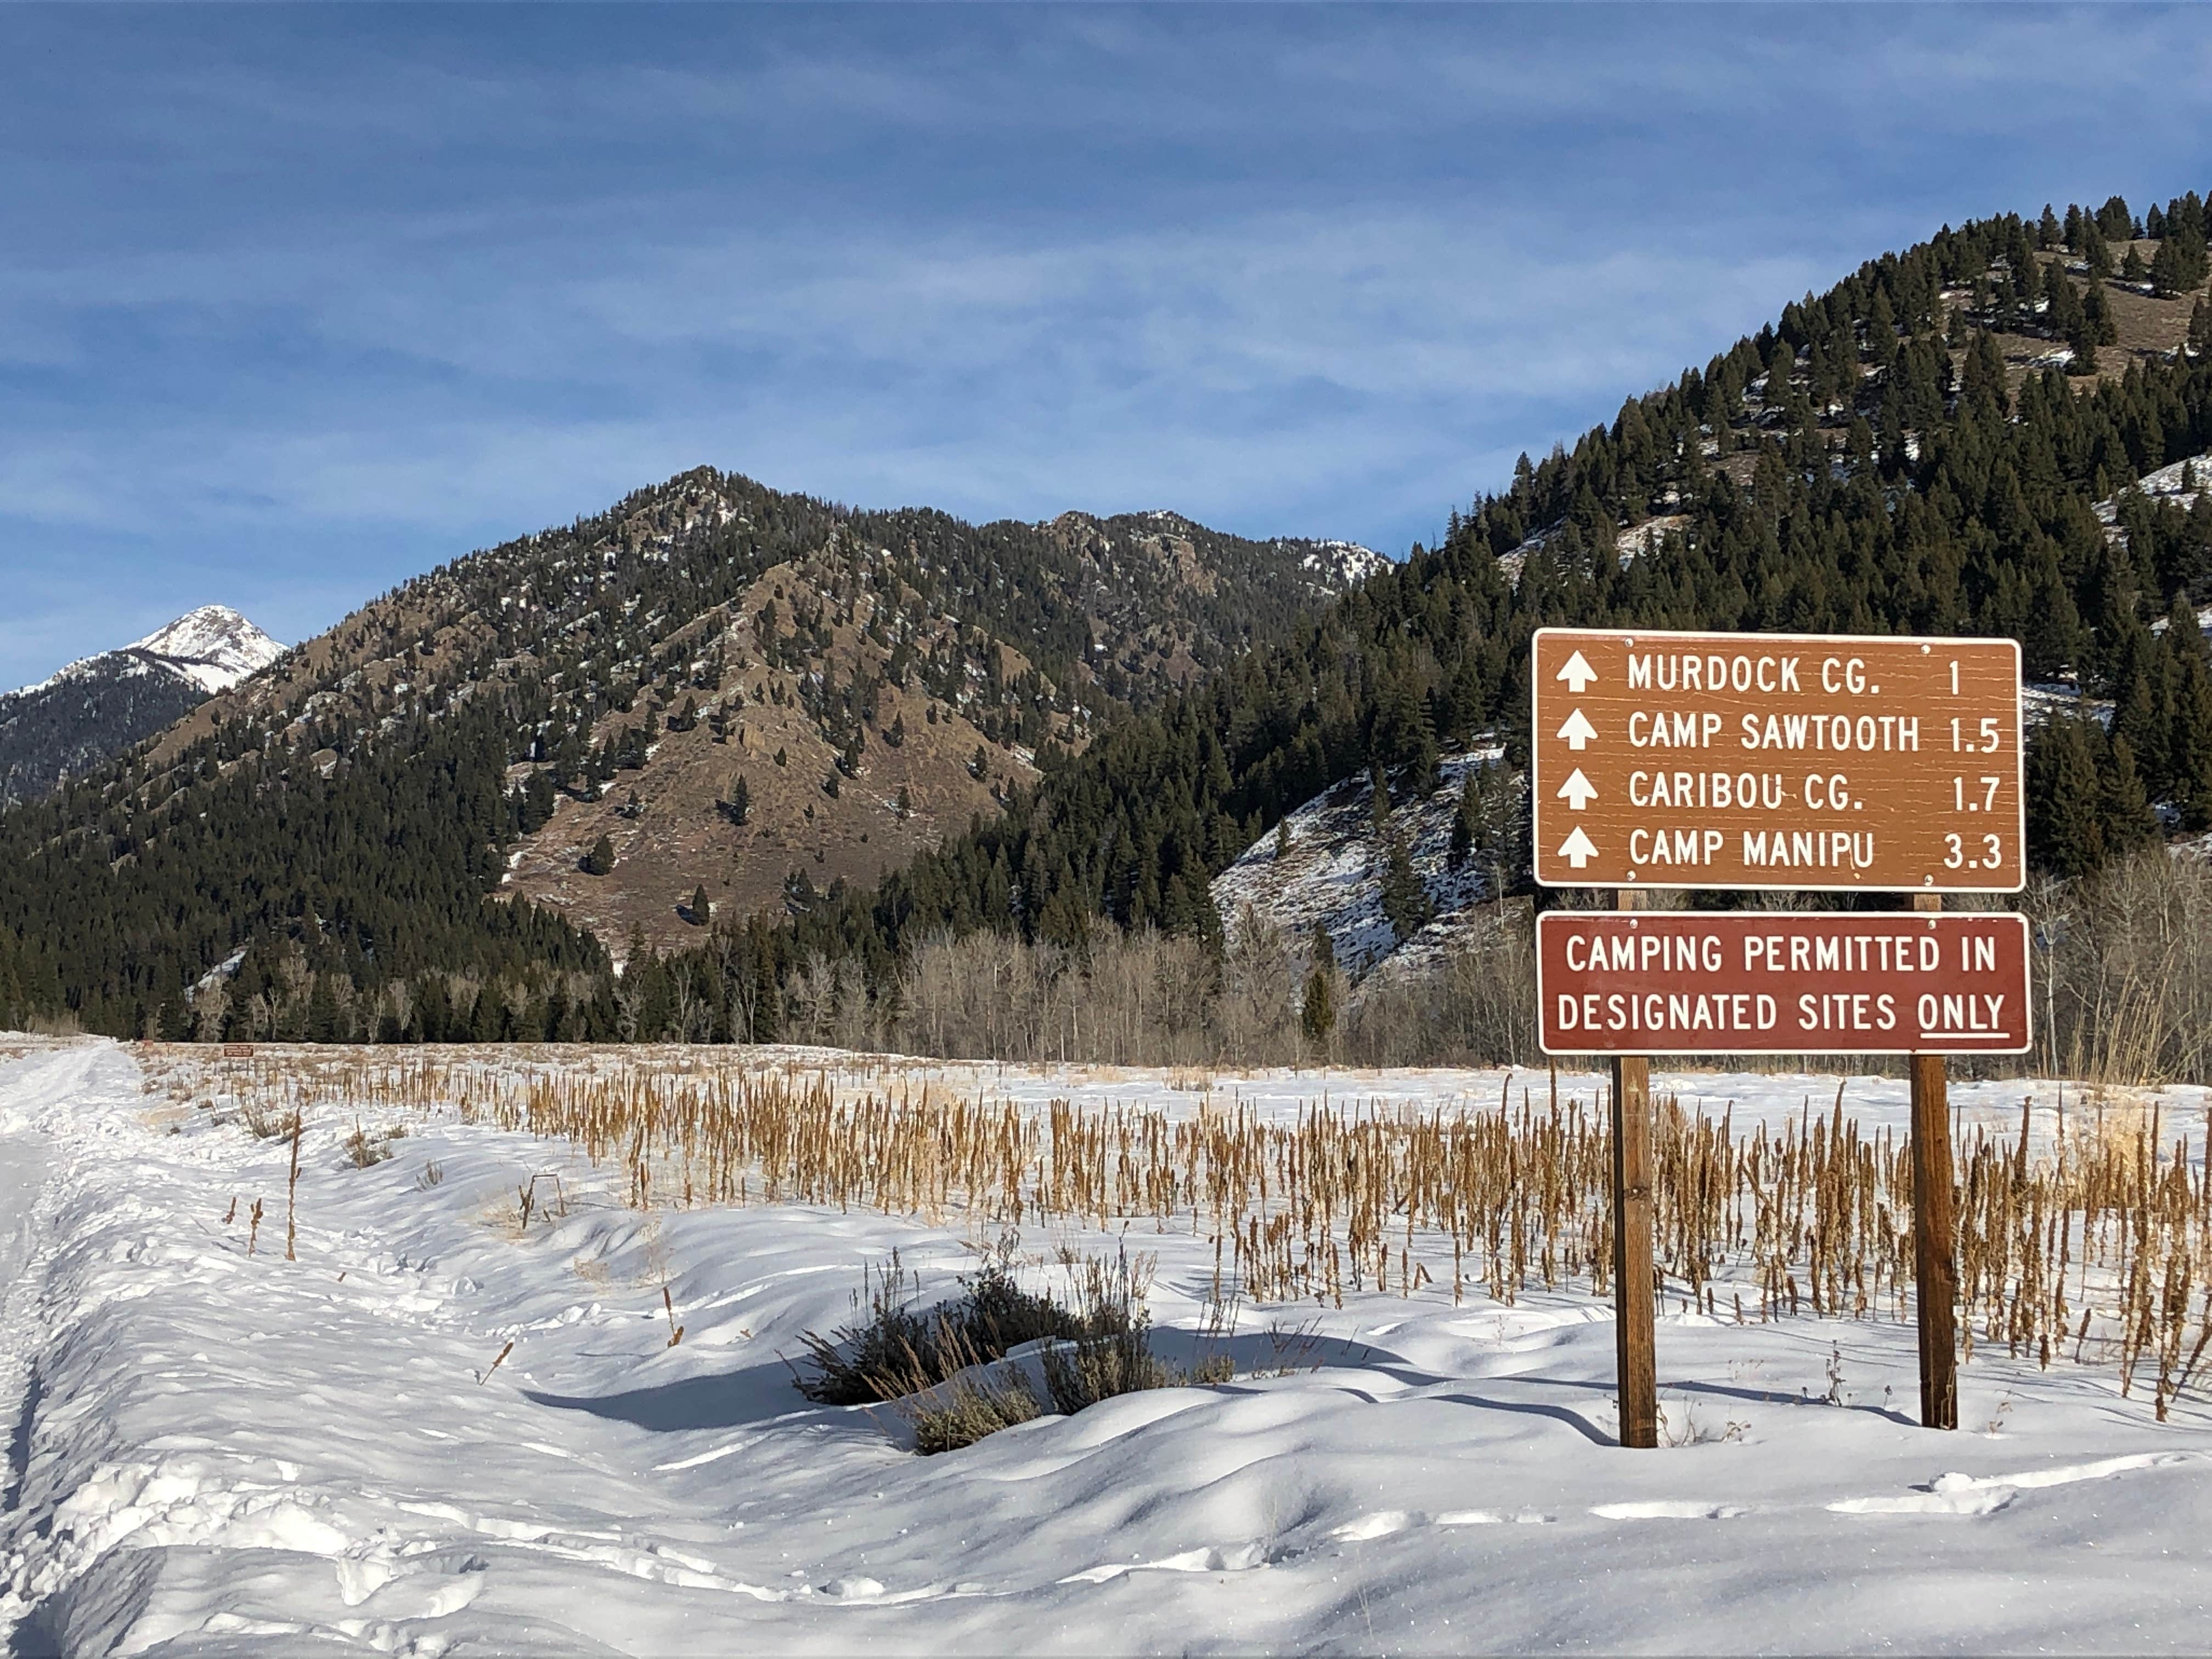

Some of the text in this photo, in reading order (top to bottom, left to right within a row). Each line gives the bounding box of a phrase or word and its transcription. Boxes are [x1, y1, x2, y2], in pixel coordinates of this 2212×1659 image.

[1628, 654, 1959, 695] MURDOCK CG. 1
[1629, 712, 2000, 753] CAMP SAWTOOTH 1.5
[1629, 771, 2000, 811] CARIBOU CG. 1.7
[1630, 829, 2001, 868] CAMP MANIPU 3.3
[1567, 935, 1995, 972] CAMPING PERMITTED IN
[1559, 994, 2004, 1030] DESIGNATED SITES ONLY
